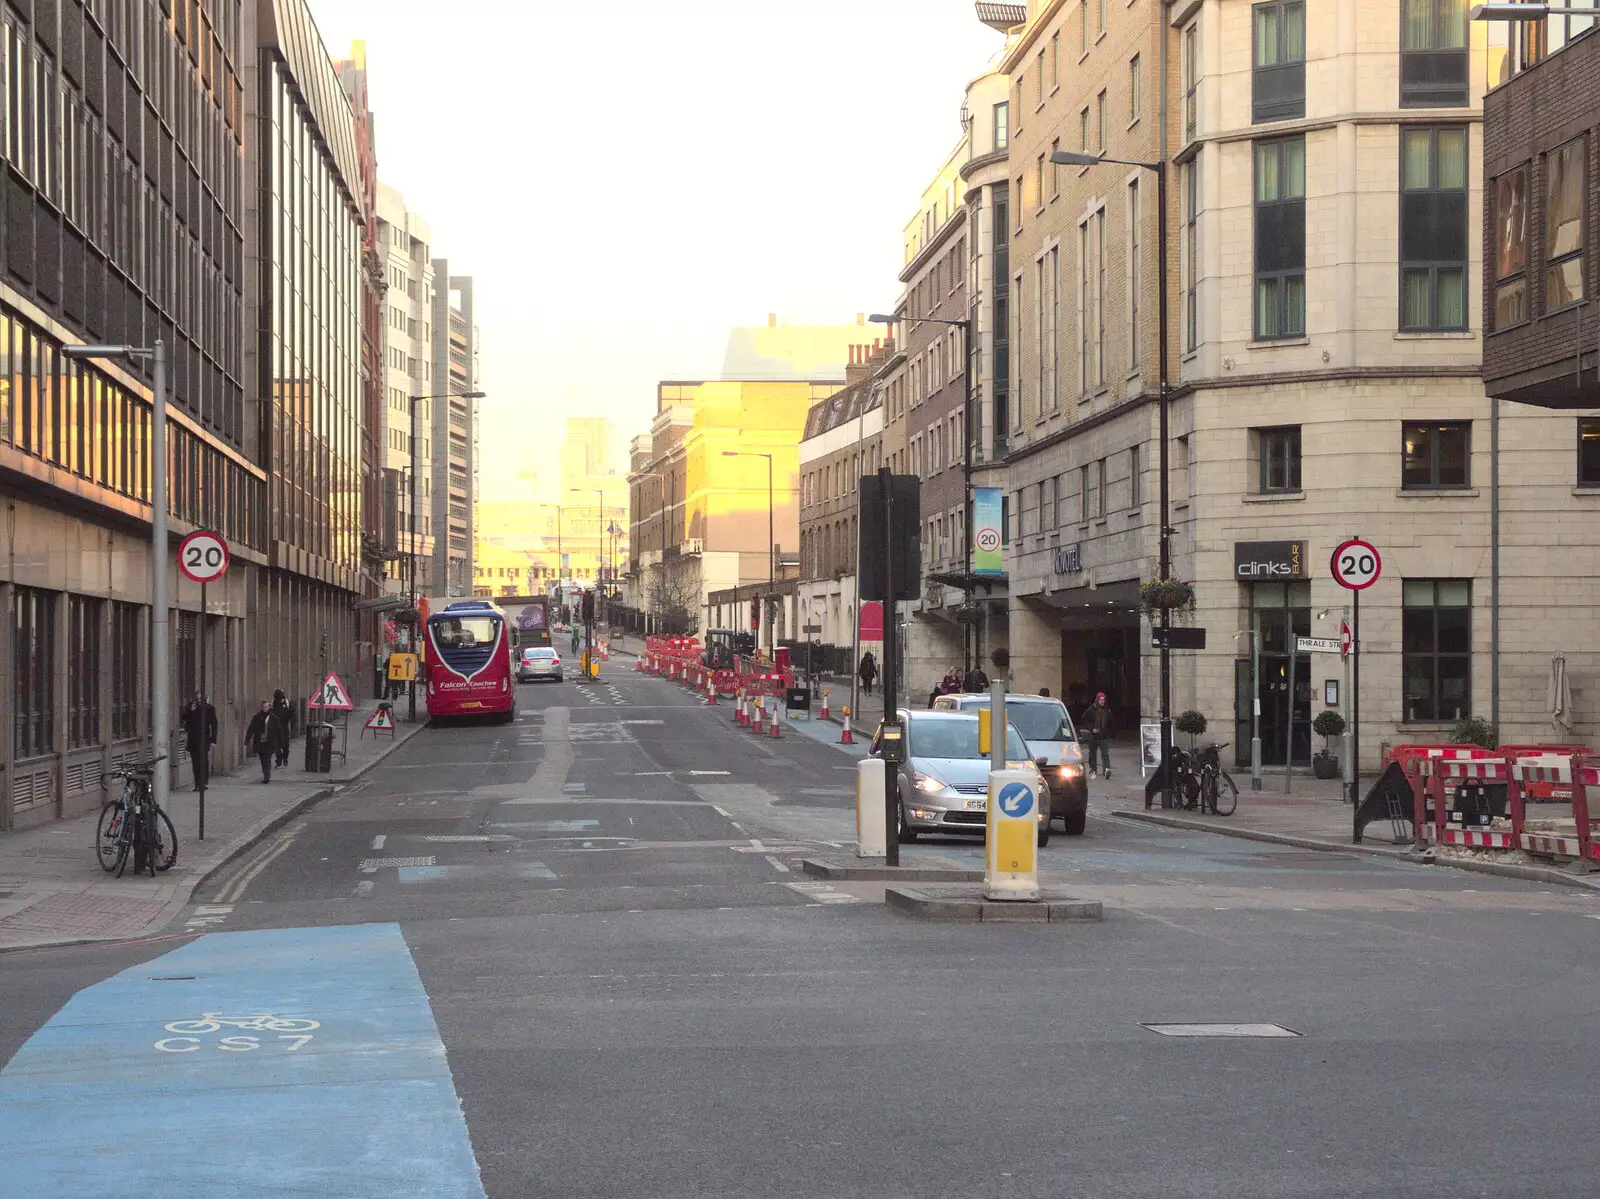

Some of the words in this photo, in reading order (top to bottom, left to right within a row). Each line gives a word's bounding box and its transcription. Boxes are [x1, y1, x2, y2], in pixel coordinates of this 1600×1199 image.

[981, 534, 996, 545] 20
[187, 547, 222, 567] 20
[1238, 561, 1291, 575] clinks
[1341, 555, 1375, 575] 20
[1299, 639, 1326, 648] THRALE
